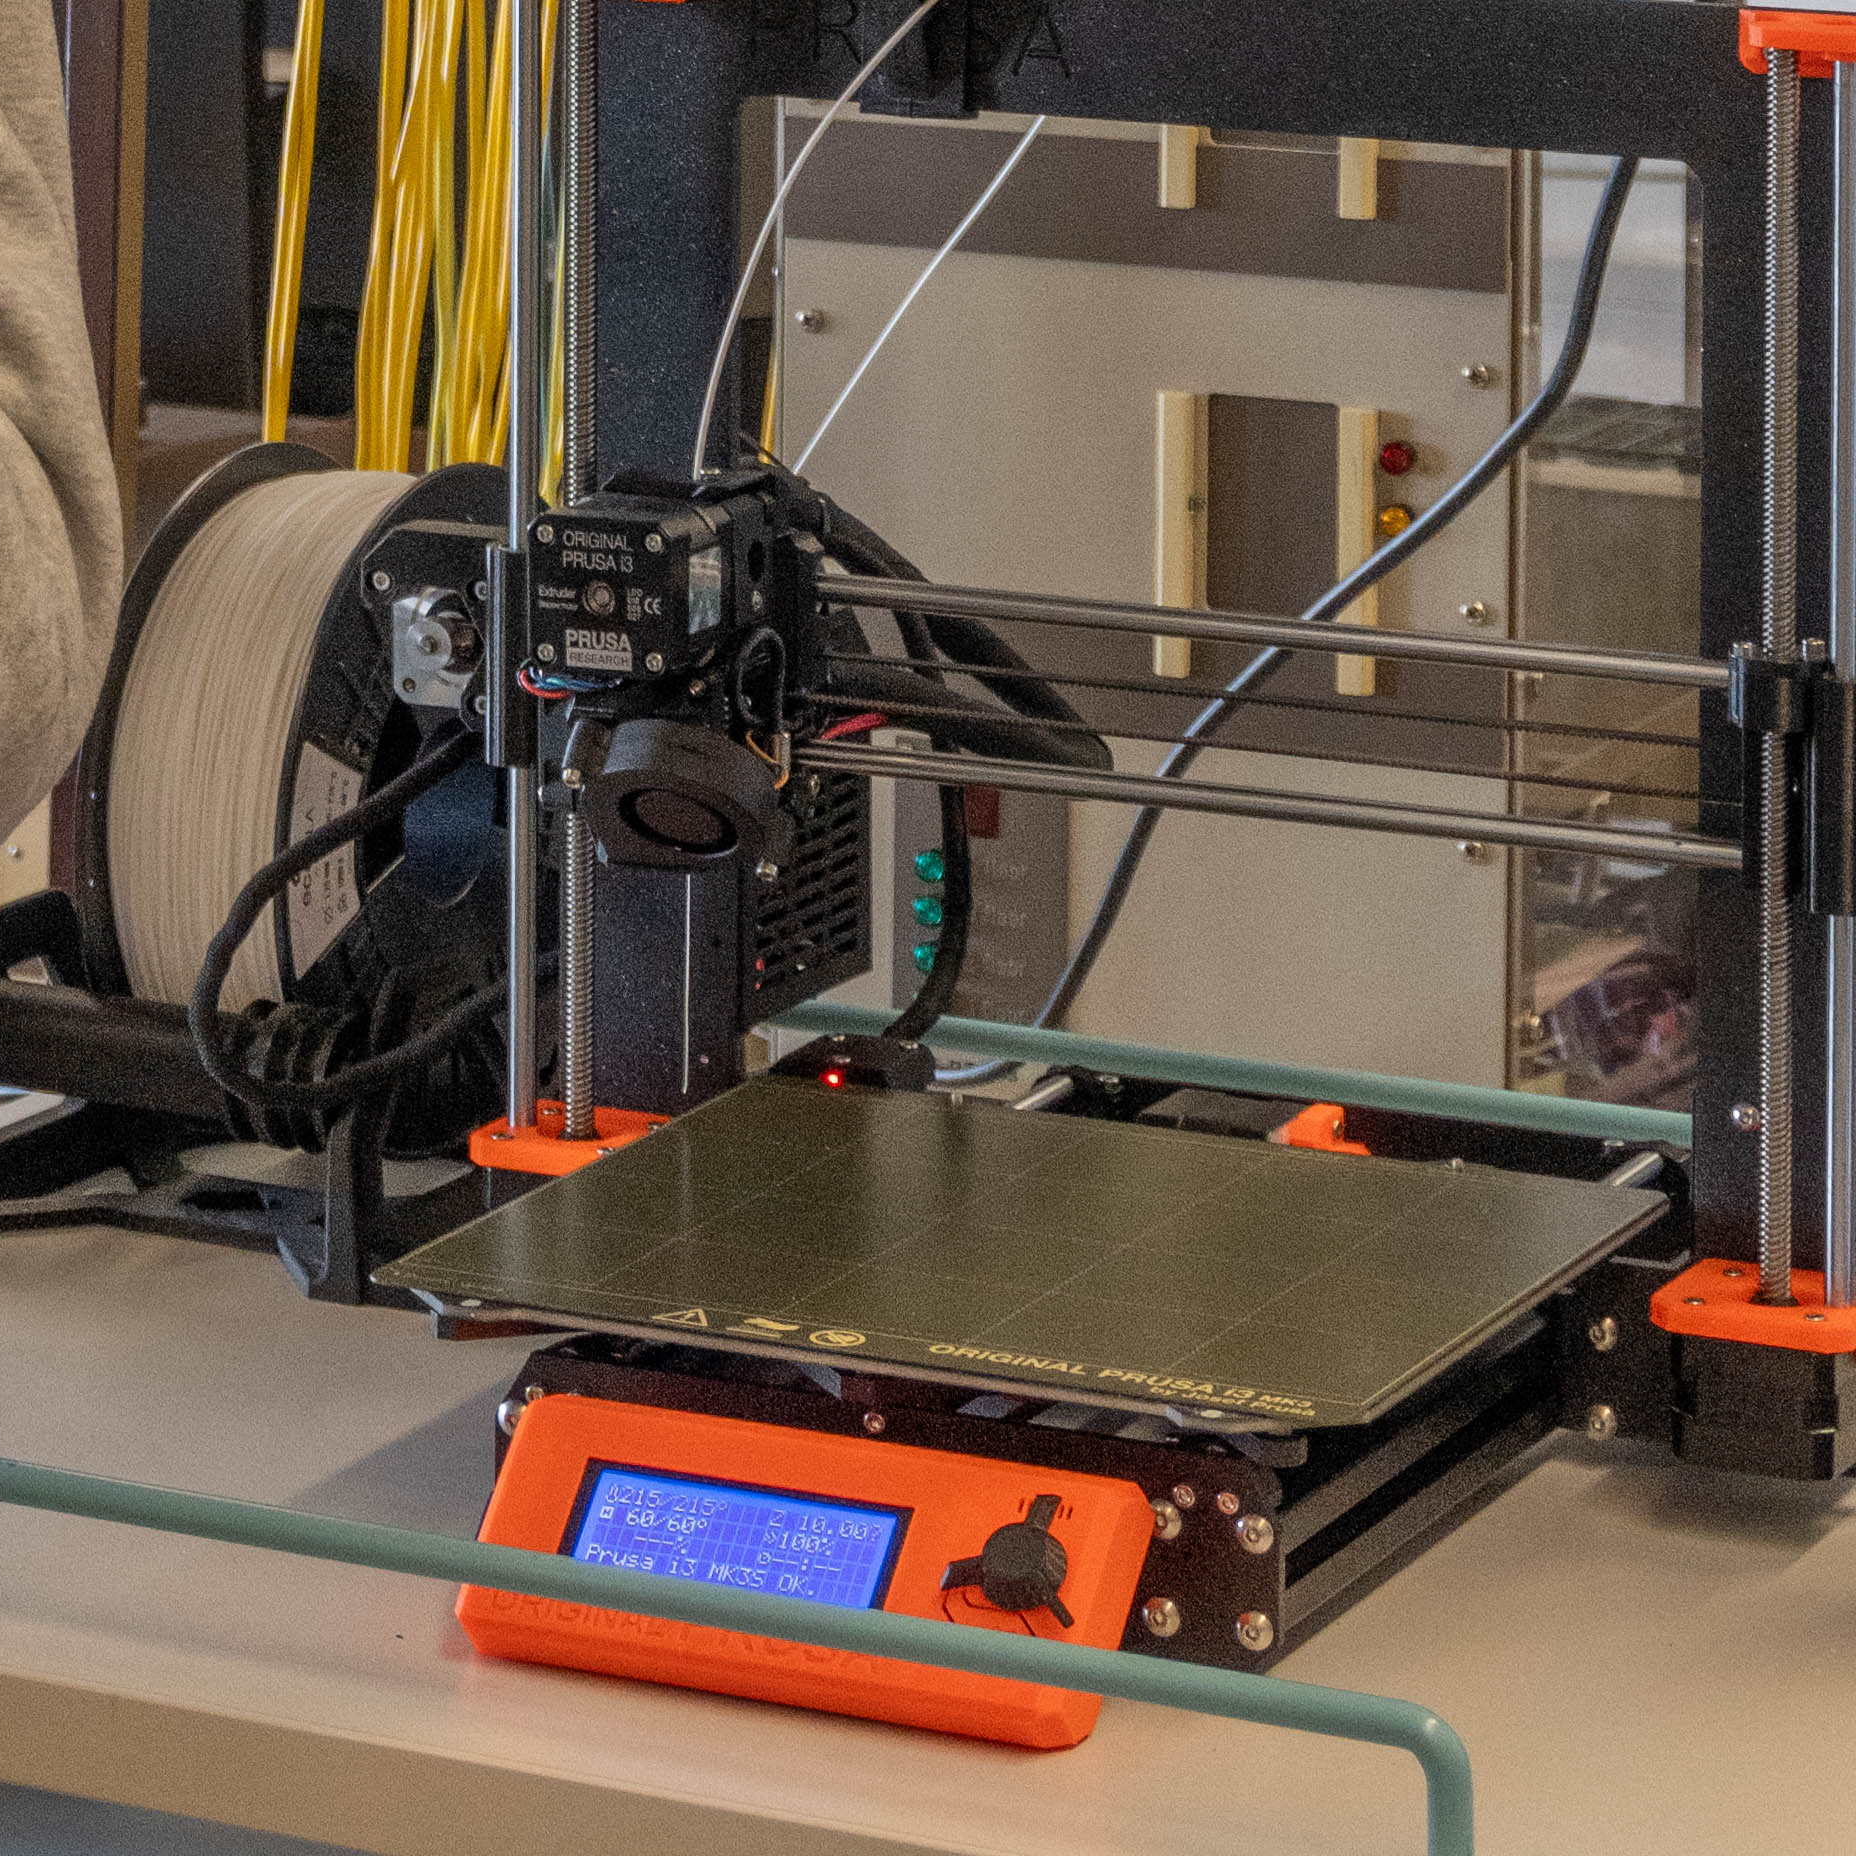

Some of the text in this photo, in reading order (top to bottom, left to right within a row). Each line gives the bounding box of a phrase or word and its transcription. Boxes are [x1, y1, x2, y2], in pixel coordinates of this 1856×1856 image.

[562, 530, 633, 552] ORIGINAL
[562, 551, 634, 574] PRUSA i3
[565, 629, 632, 651] PRUSA
[569, 652, 629, 666] RESEARCH
[929, 1344, 1087, 1376] ORIGINAL
[1098, 1369, 1215, 1394] PRUSA
[586, 1544, 655, 1571] Prusa
[669, 1558, 697, 1577] i3
